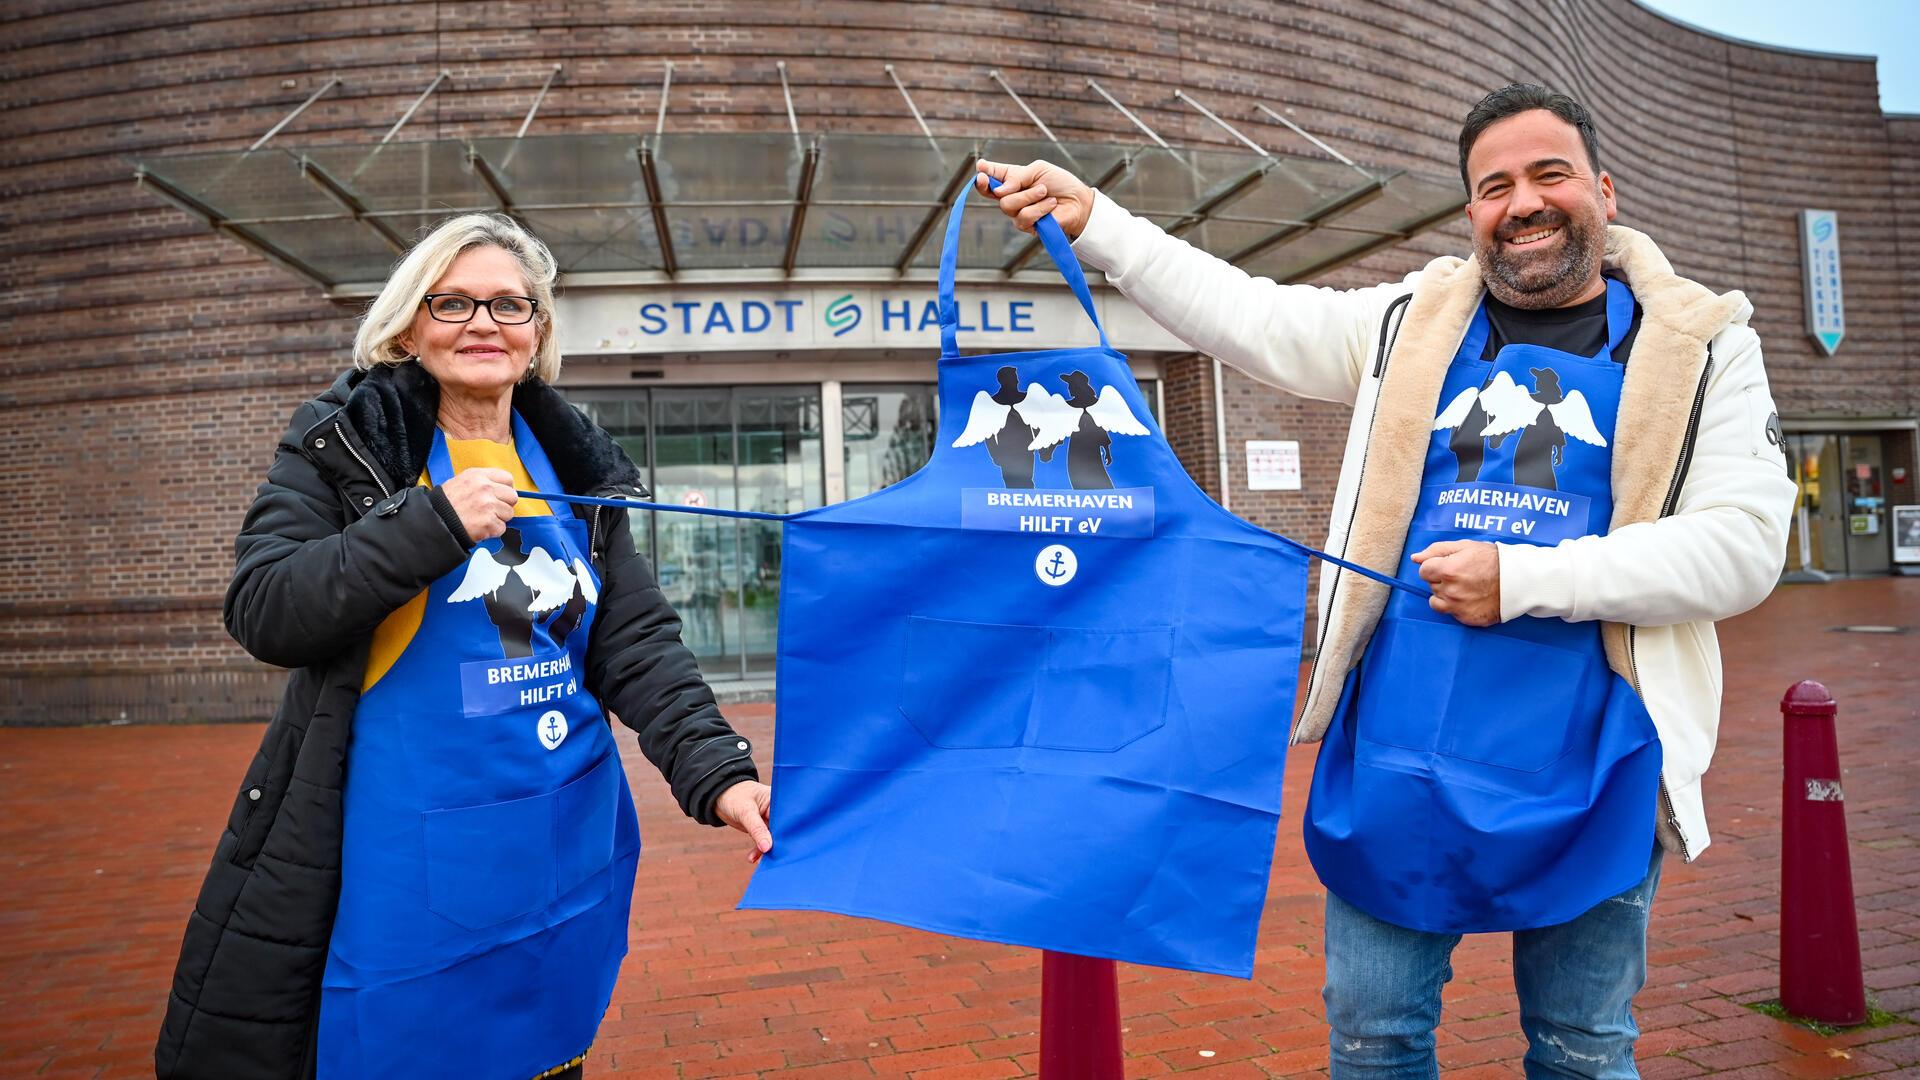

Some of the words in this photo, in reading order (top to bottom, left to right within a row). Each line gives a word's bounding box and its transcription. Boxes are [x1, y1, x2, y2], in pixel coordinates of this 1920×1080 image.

[1813, 248, 1825, 327] TICKET
[1827, 249, 1841, 328] CENTER
[640, 300, 803, 334] STADT
[881, 299, 1035, 332] HALLE
[987, 492, 1133, 510] BREMERHAVEN
[1437, 488, 1570, 517] BREMERHAVEN
[1019, 515, 1073, 533] HILFT
[1078, 516, 1102, 533] eV
[1454, 512, 1508, 532] HILFT
[1511, 519, 1536, 536] eV
[487, 650, 571, 685] BREMERHA
[520, 683, 564, 706] HILFT
[567, 677, 577, 696] eV
